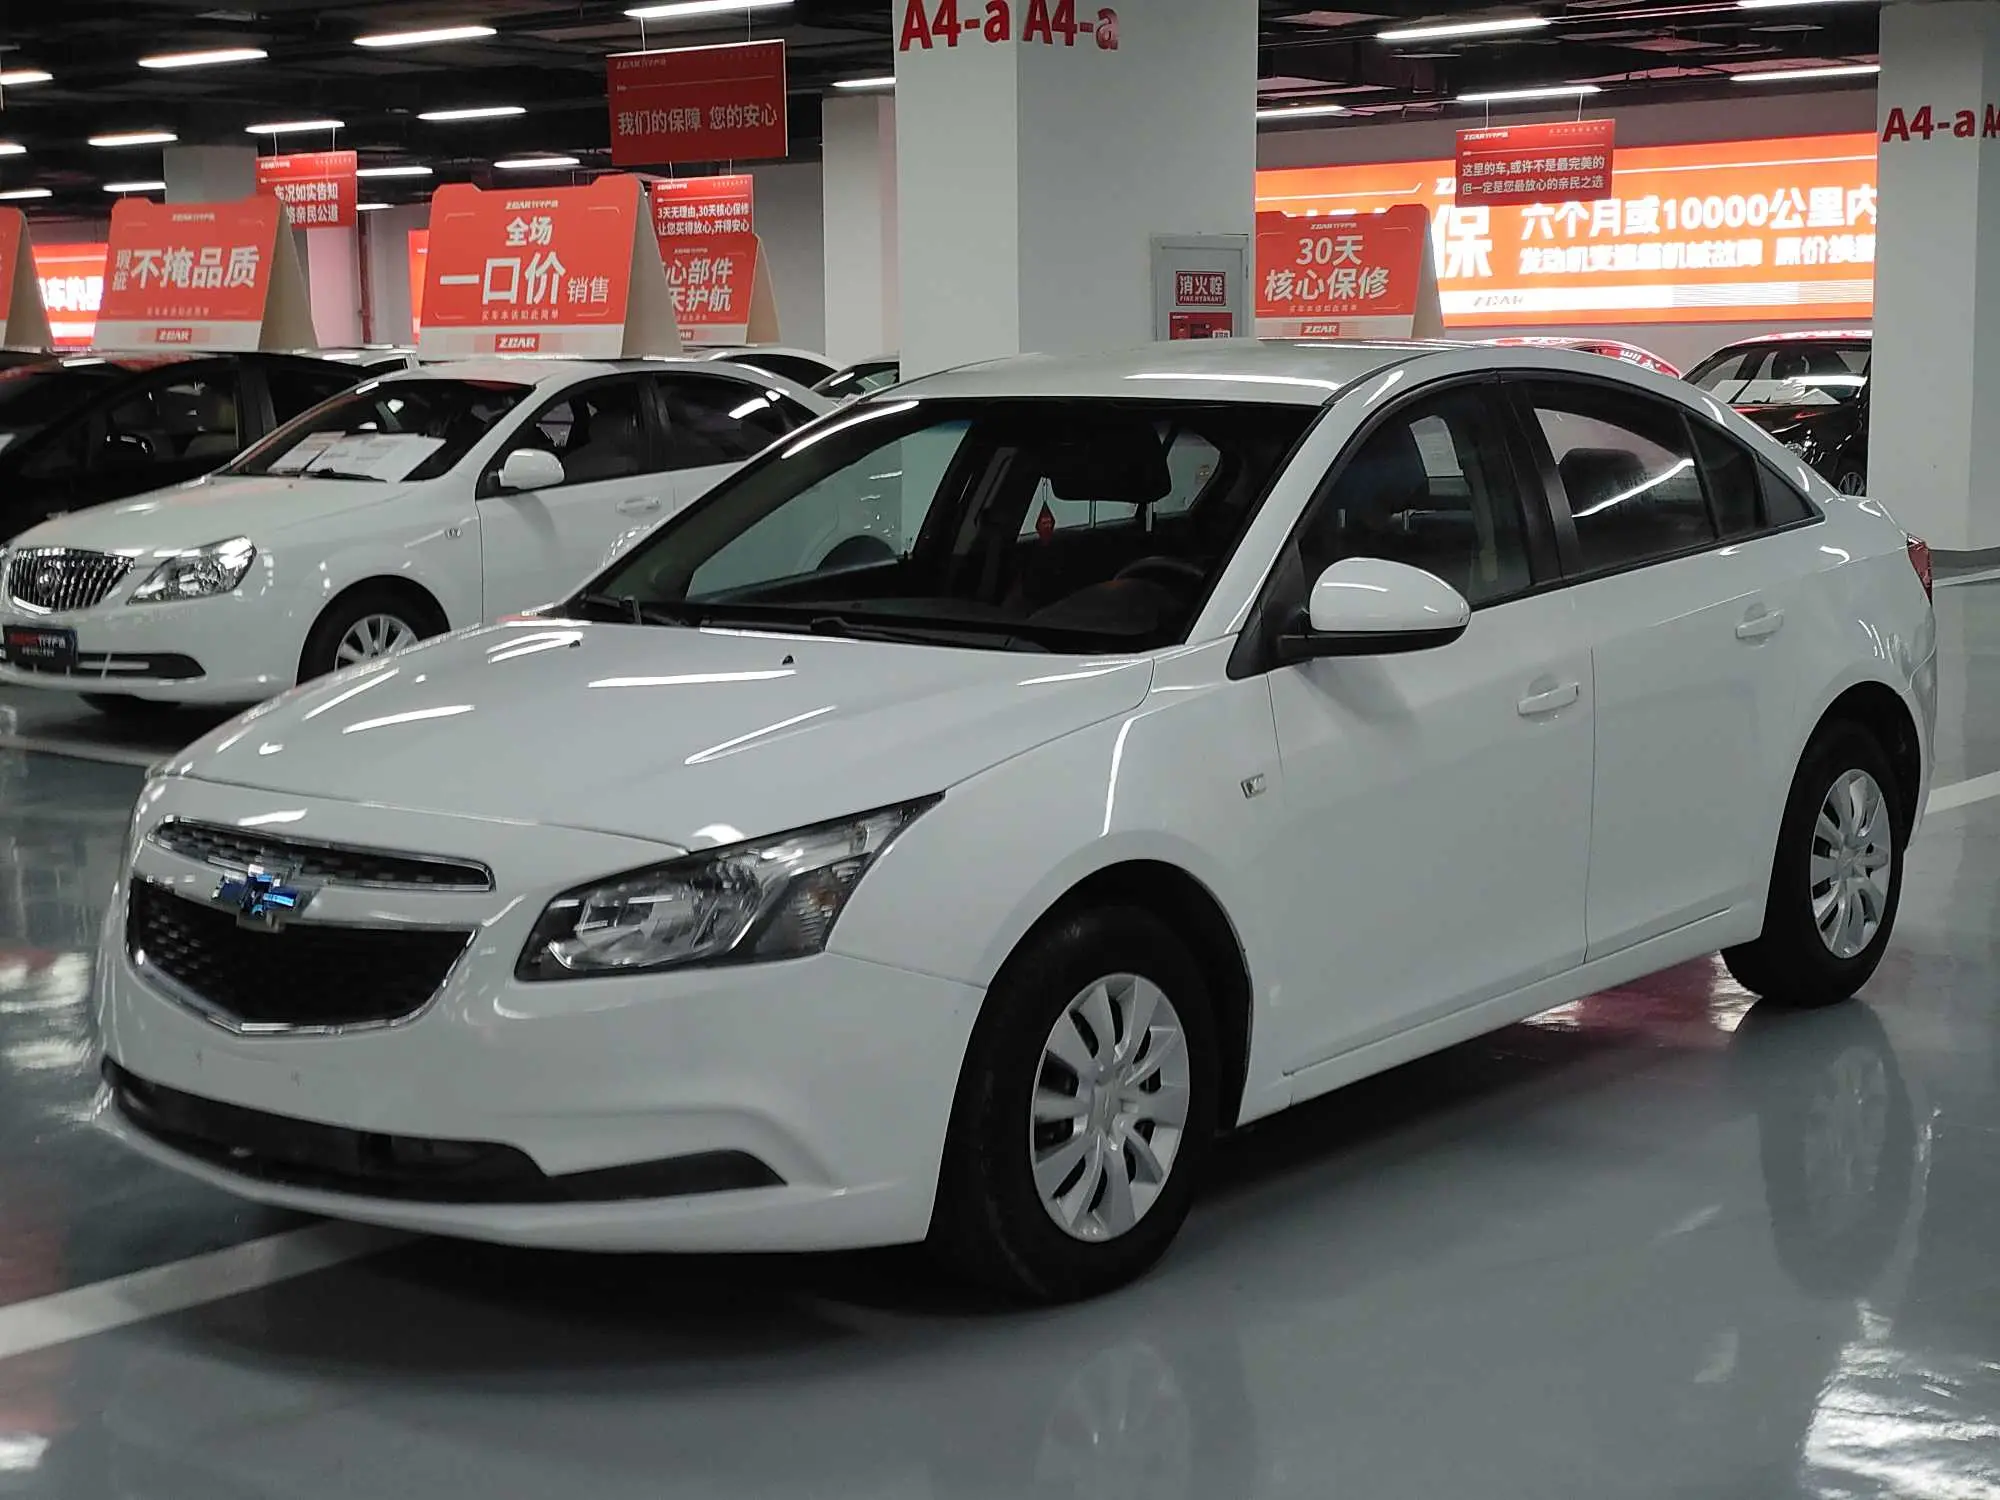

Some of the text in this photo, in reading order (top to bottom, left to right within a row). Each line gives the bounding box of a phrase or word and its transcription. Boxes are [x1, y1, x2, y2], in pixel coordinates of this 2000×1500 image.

[899, 0, 1011, 51] A4-a
[1022, 0, 1121, 50] A4-a
[618, 103, 777, 136] 我们的保障 您的安心
[1882, 105, 1975, 142] A4-a
[1983, 104, 2000, 138] A
[1462, 155, 1605, 177] 这里的车,或许不是最完美的
[1462, 176, 1604, 195] 但一定是您最放心的亲民之选
[1520, 183, 1877, 241] 六个月或10000公里内
[505, 216, 554, 247] 全场
[1296, 234, 1363, 266] 30天
[131, 245, 259, 290] 不掩品质
[439, 251, 609, 305] 一口价 销售
[663, 258, 733, 285] 心部件
[1264, 266, 1389, 302] 核心保修
[1180, 275, 1223, 295] 消火栓
[1303, 325, 1337, 334] ZCAR
